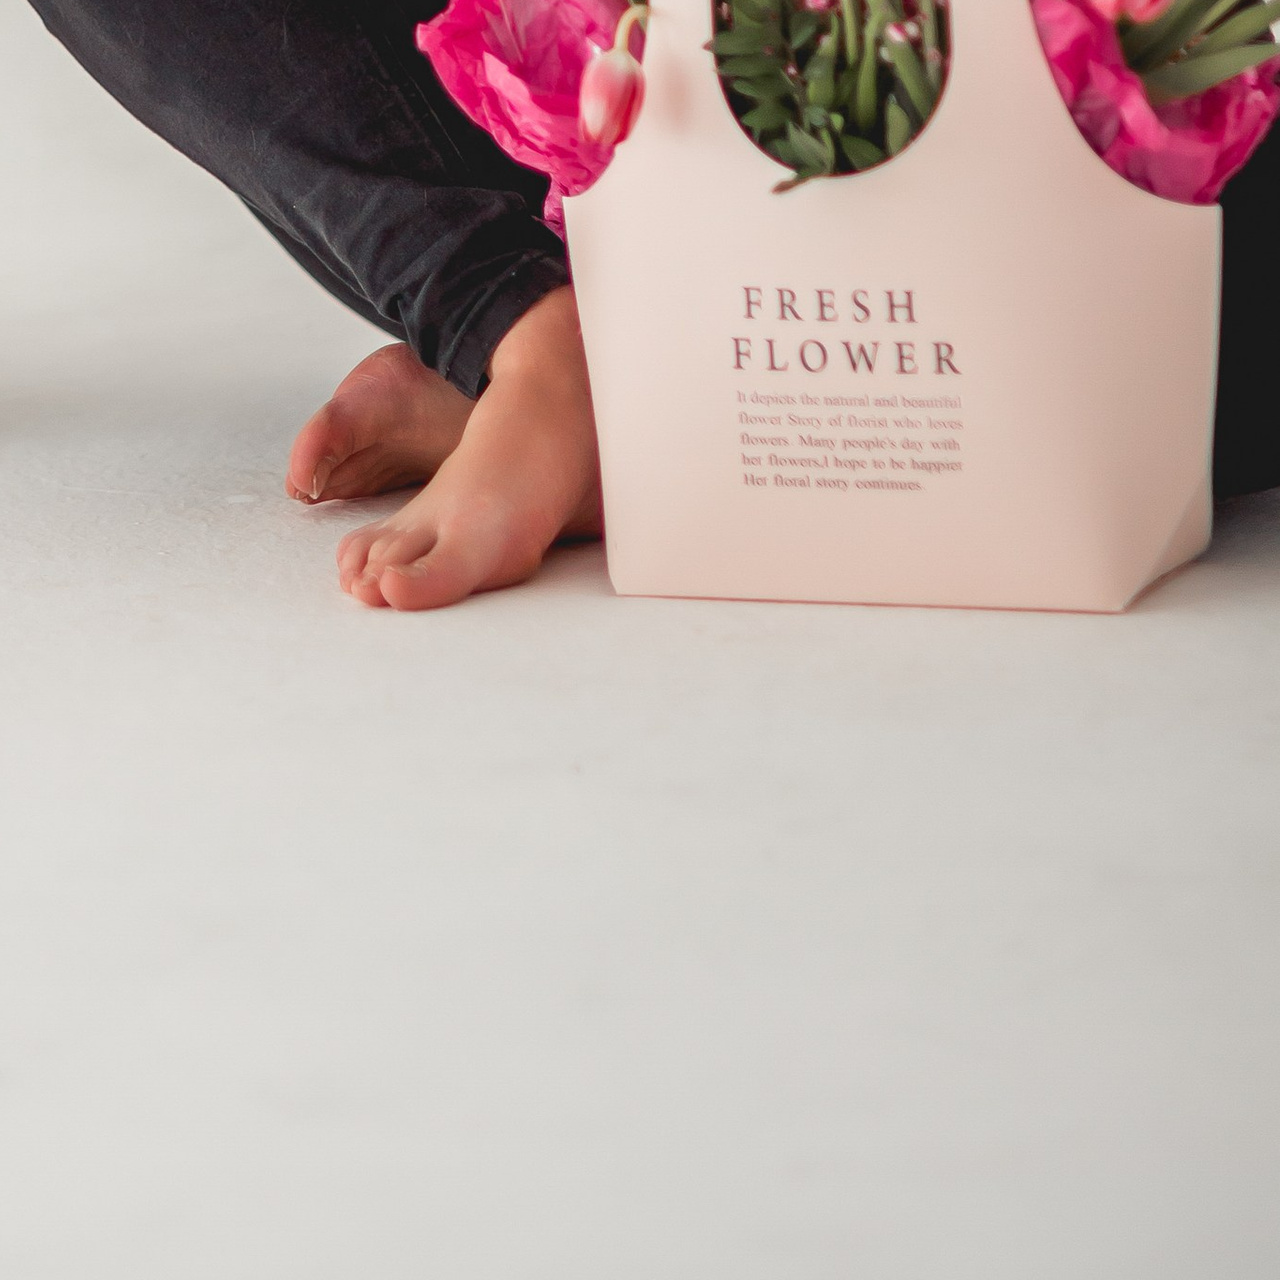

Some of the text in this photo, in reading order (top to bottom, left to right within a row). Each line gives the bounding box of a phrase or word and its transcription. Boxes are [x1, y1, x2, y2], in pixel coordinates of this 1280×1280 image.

[742, 285, 918, 323] FRESH
[731, 336, 962, 375] FLOWER
[737, 390, 962, 408] It depicts the natural and beautiful
[738, 412, 963, 430] flower Story of florist who loves
[798, 435, 836, 450] Many
[902, 438, 924, 452] day
[931, 439, 960, 451] with
[741, 453, 762, 465] her
[834, 456, 867, 471] hope
[873, 458, 886, 469] to
[890, 457, 906, 470] be
[911, 458, 963, 473] happier
[743, 473, 768, 486] Her
[774, 474, 810, 488] floral
[816, 478, 849, 492] story
